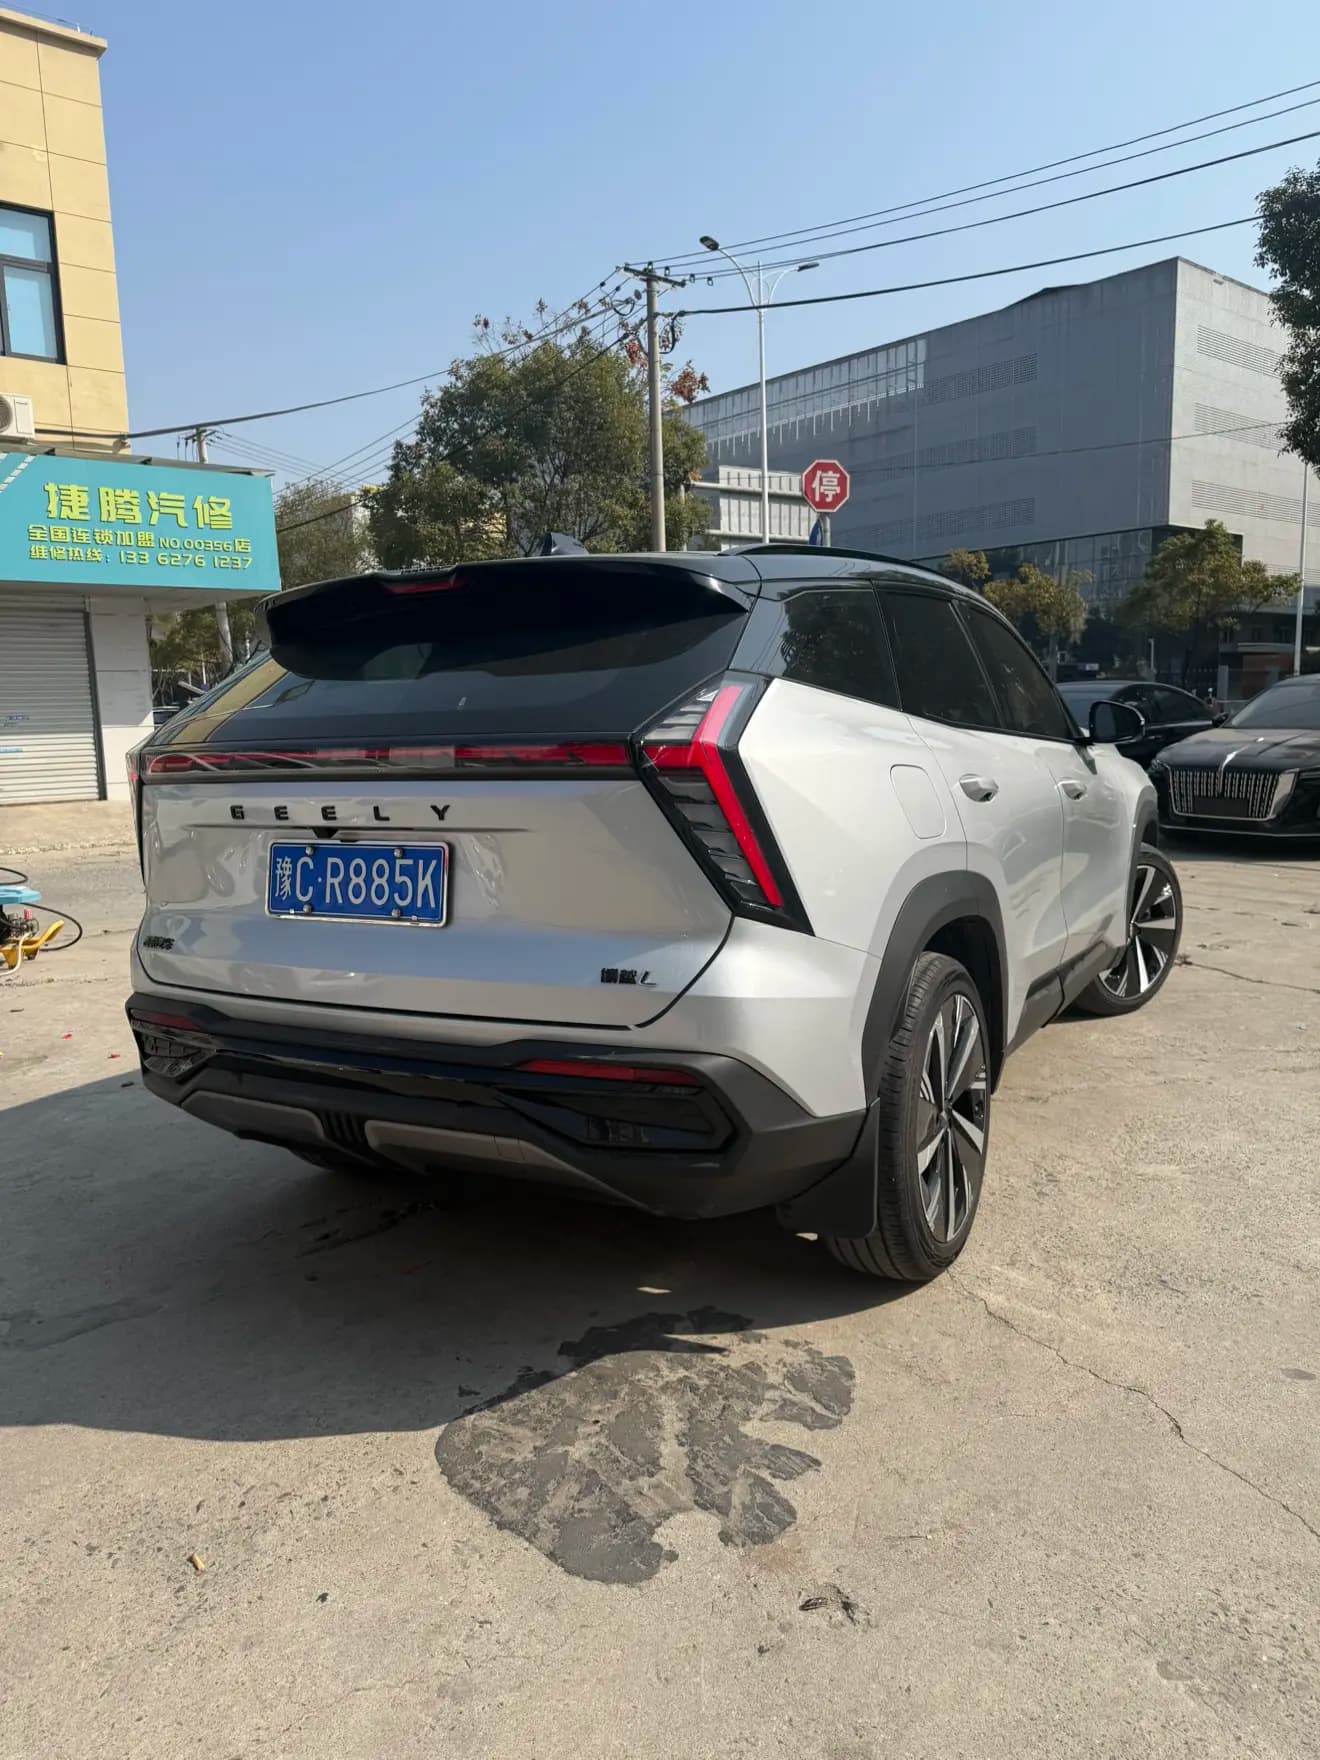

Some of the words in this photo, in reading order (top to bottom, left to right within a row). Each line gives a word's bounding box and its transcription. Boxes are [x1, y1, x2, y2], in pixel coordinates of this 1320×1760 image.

[811, 470, 841, 502] 停
[44, 482, 233, 529] 捷腾汽修
[119, 550, 149, 565] 133
[156, 552, 206, 567] 6276
[213, 555, 253, 569] 1237
[230, 805, 450, 821] GEELY
